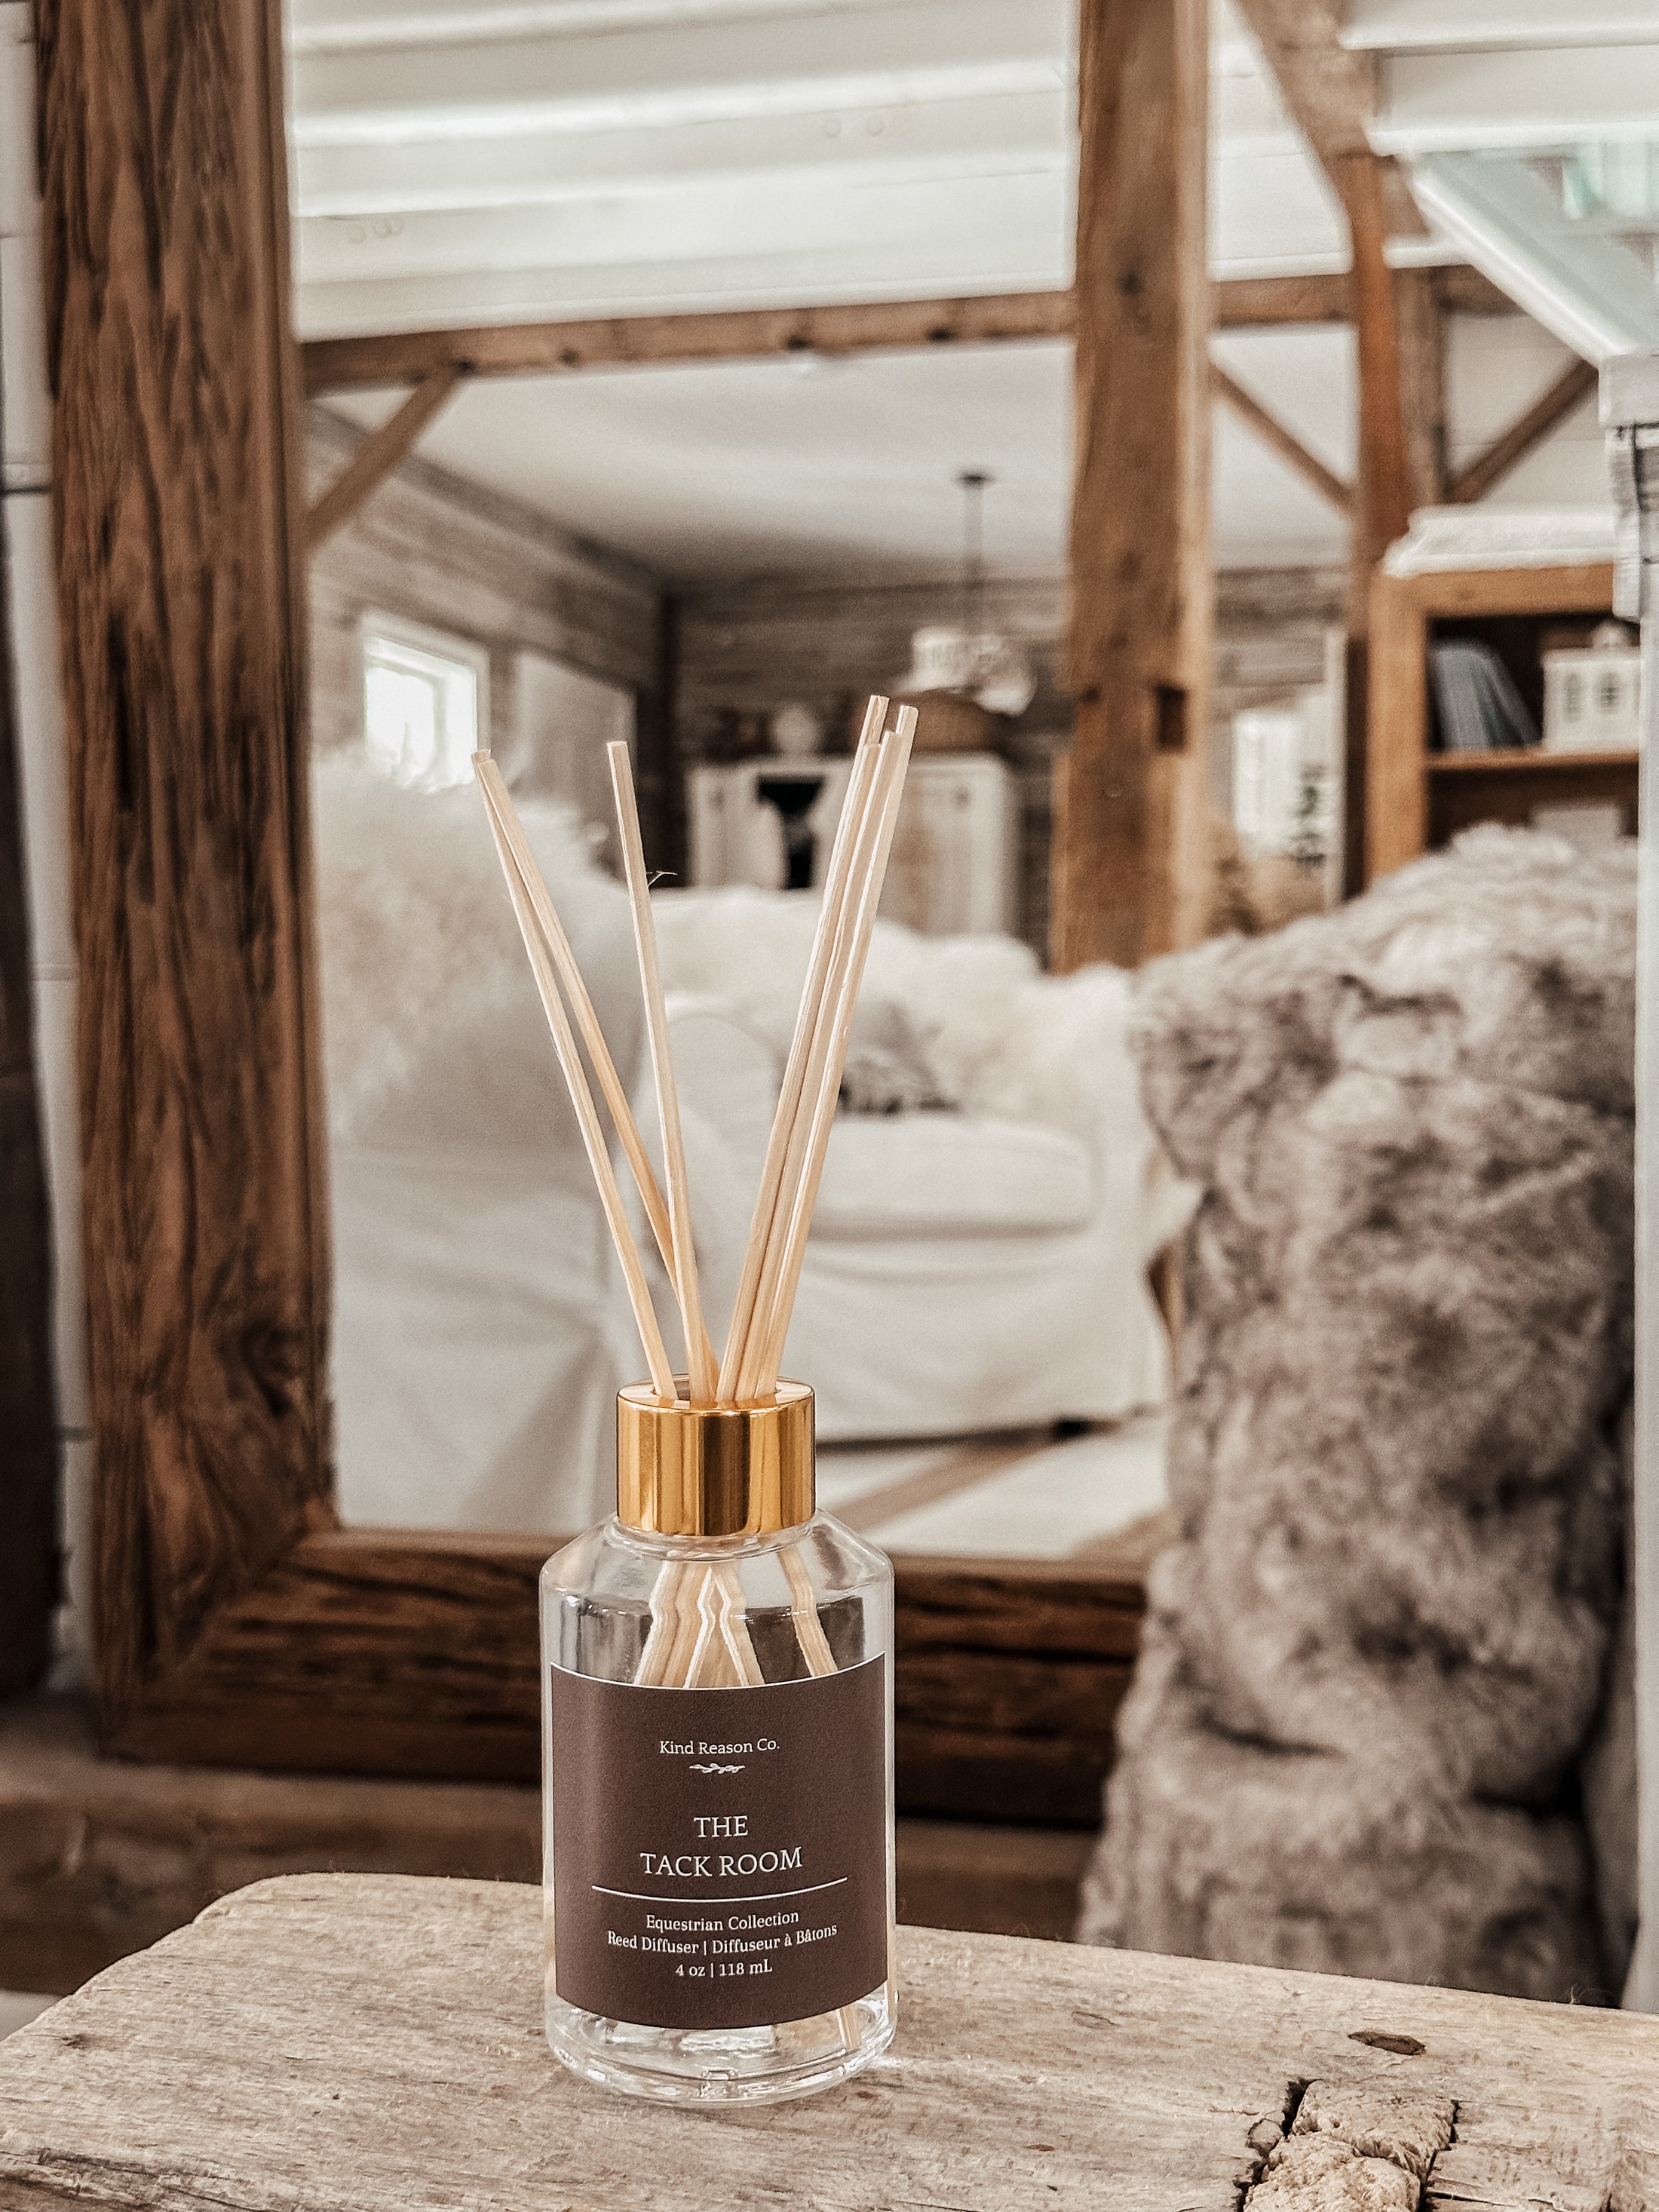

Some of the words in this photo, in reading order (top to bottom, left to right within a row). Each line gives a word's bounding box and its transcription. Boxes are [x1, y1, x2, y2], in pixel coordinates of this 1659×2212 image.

[659, 1740, 695, 1755] Kind
[698, 1741, 753, 1755] Reason
[756, 1738, 780, 1751] Co.
[693, 1815, 749, 1838] THE
[639, 1852, 713, 1877] TACK
[719, 1846, 803, 1876] ROOM
[646, 1914, 724, 1934] Equestrian
[728, 1912, 799, 1931] Collection
[607, 1930, 638, 1950] Reed
[641, 1936, 700, 1954] Diffuser
[712, 1937, 781, 1954] Diffuseur
[784, 1933, 793, 1947] à
[796, 1925, 837, 1945] Bâtons
[675, 1964, 685, 1977] 4
[688, 1966, 706, 1977] oz
[719, 1962, 745, 1977] 118
[749, 1959, 773, 1974] mL
